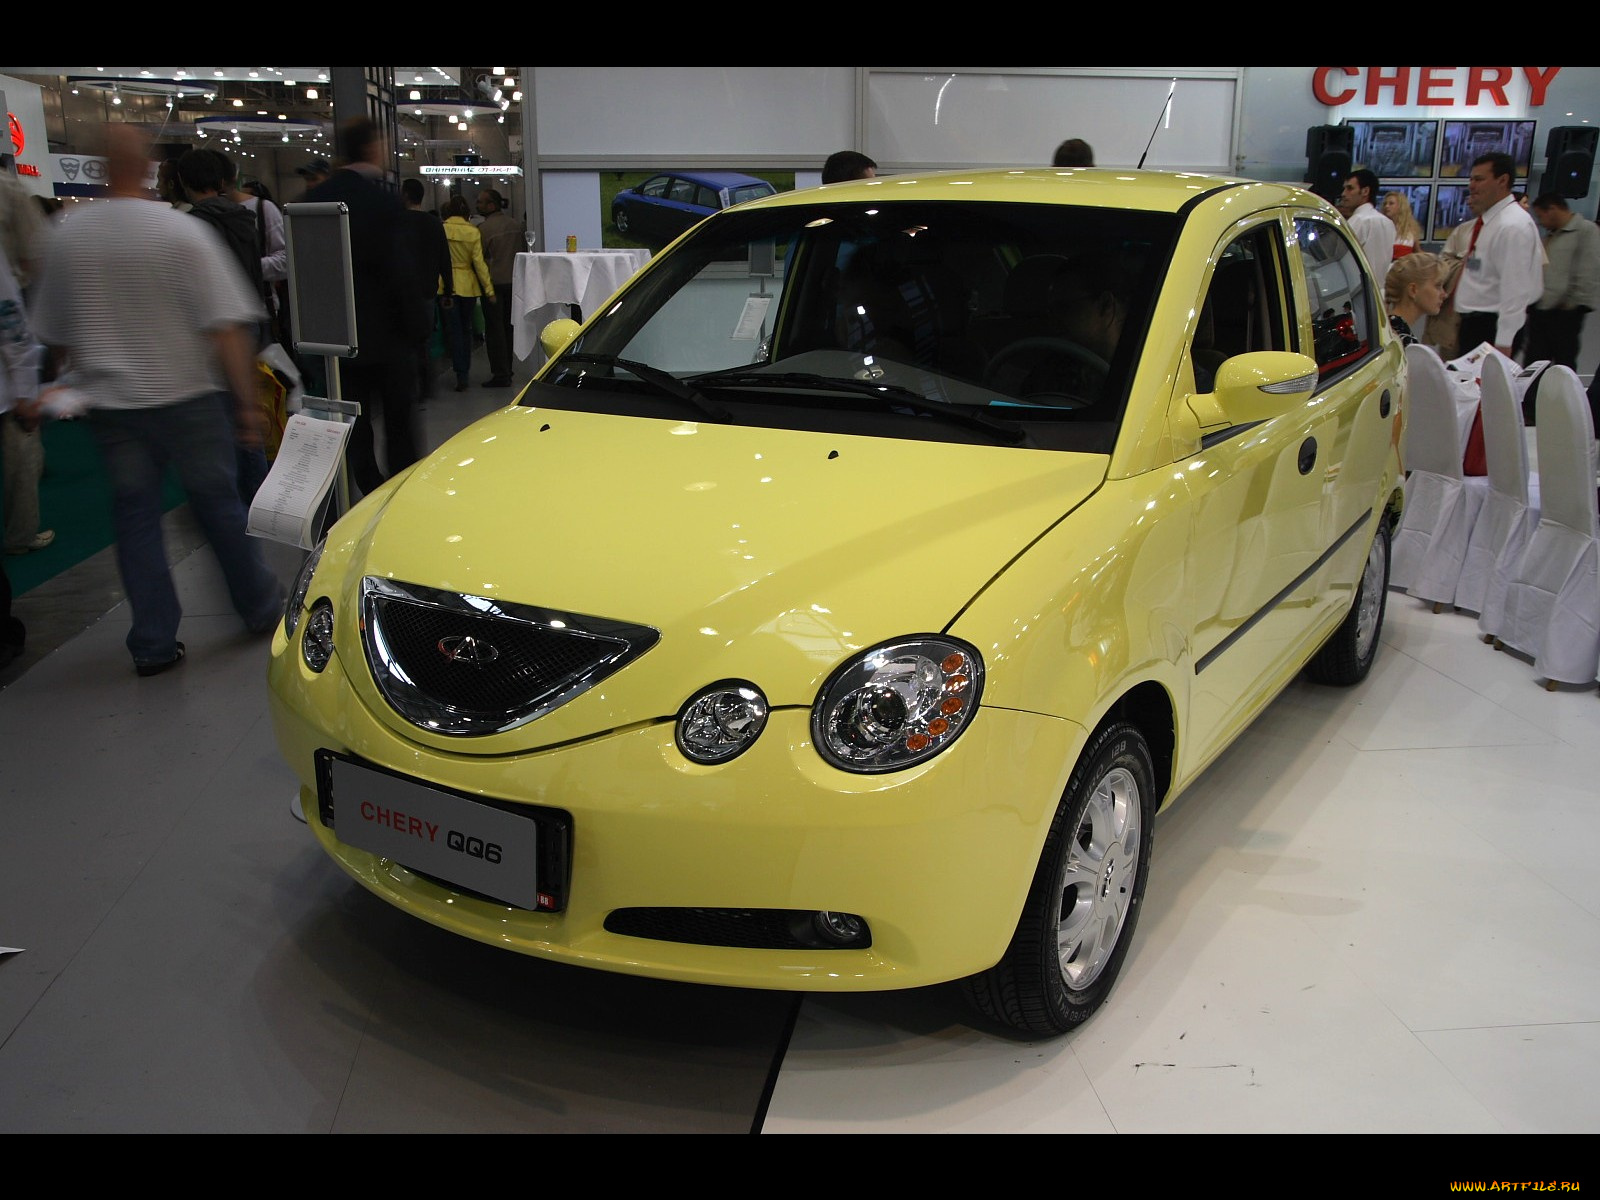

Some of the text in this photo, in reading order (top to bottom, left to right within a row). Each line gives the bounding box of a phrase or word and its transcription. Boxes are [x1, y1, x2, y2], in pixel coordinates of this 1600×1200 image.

[1312, 67, 1562, 106] CHERY
[1111, 740, 1127, 759] 128
[360, 801, 503, 865] CHERY QQ6
